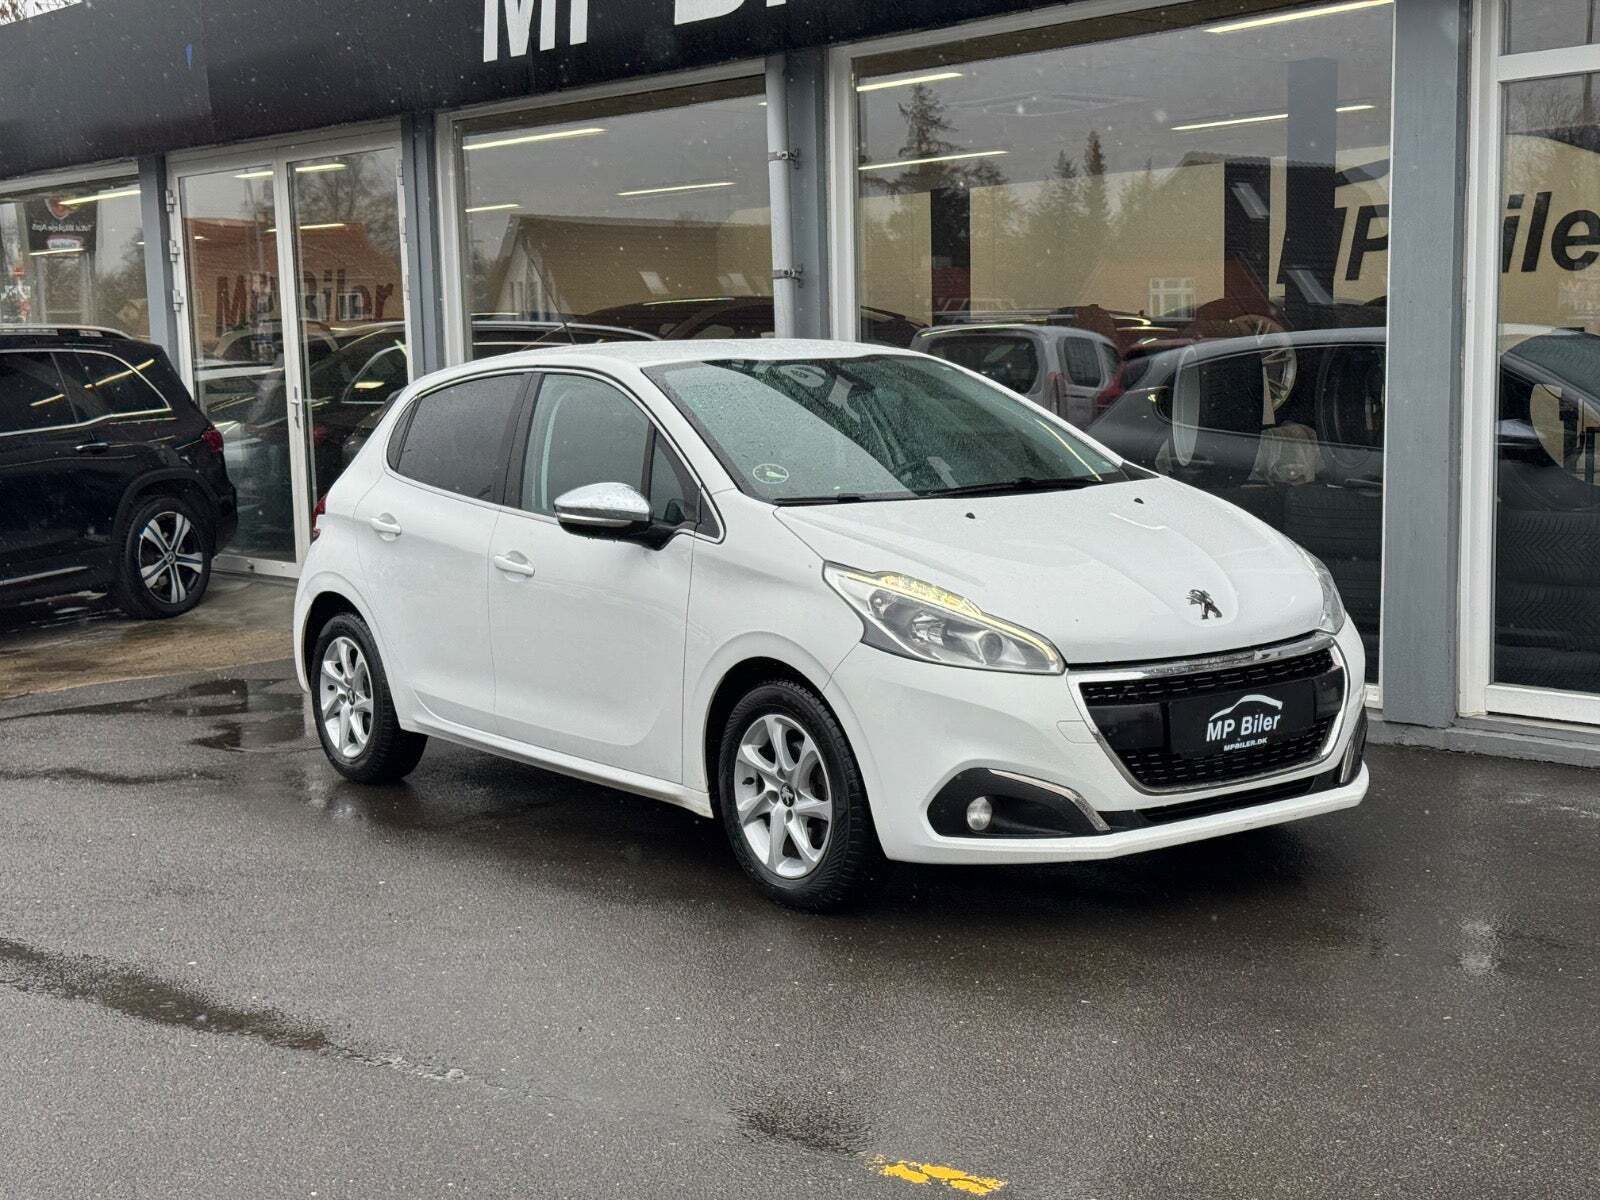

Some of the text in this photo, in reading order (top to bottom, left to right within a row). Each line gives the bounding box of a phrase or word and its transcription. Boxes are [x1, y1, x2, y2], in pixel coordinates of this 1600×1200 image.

[1502, 191, 1600, 273] ile
[1206, 713, 1281, 742] MP Biler
[1223, 737, 1268, 752] MPBILER.DK
